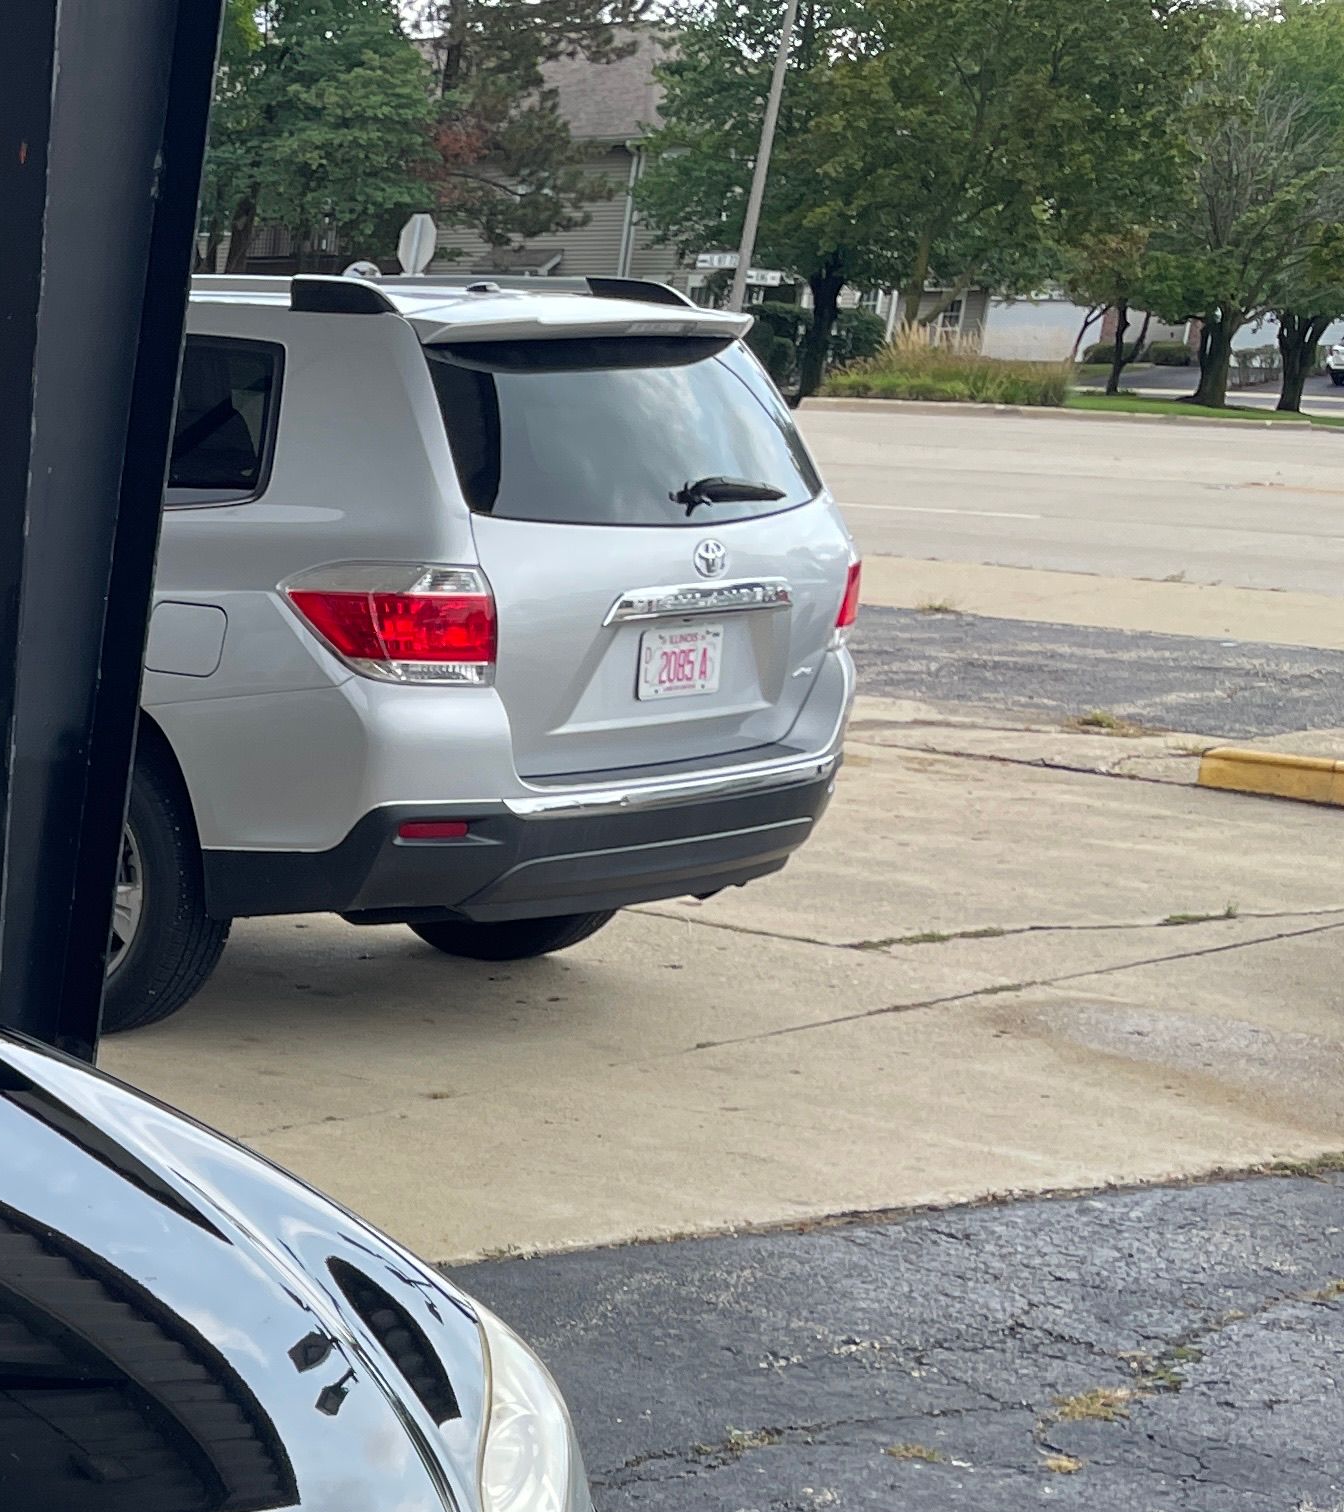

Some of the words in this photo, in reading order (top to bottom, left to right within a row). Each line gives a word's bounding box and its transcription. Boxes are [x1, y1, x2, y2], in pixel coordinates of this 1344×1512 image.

[669, 632, 699, 644] ILLINOIS
[658, 649, 696, 684] 2085
[699, 647, 708, 680] A
